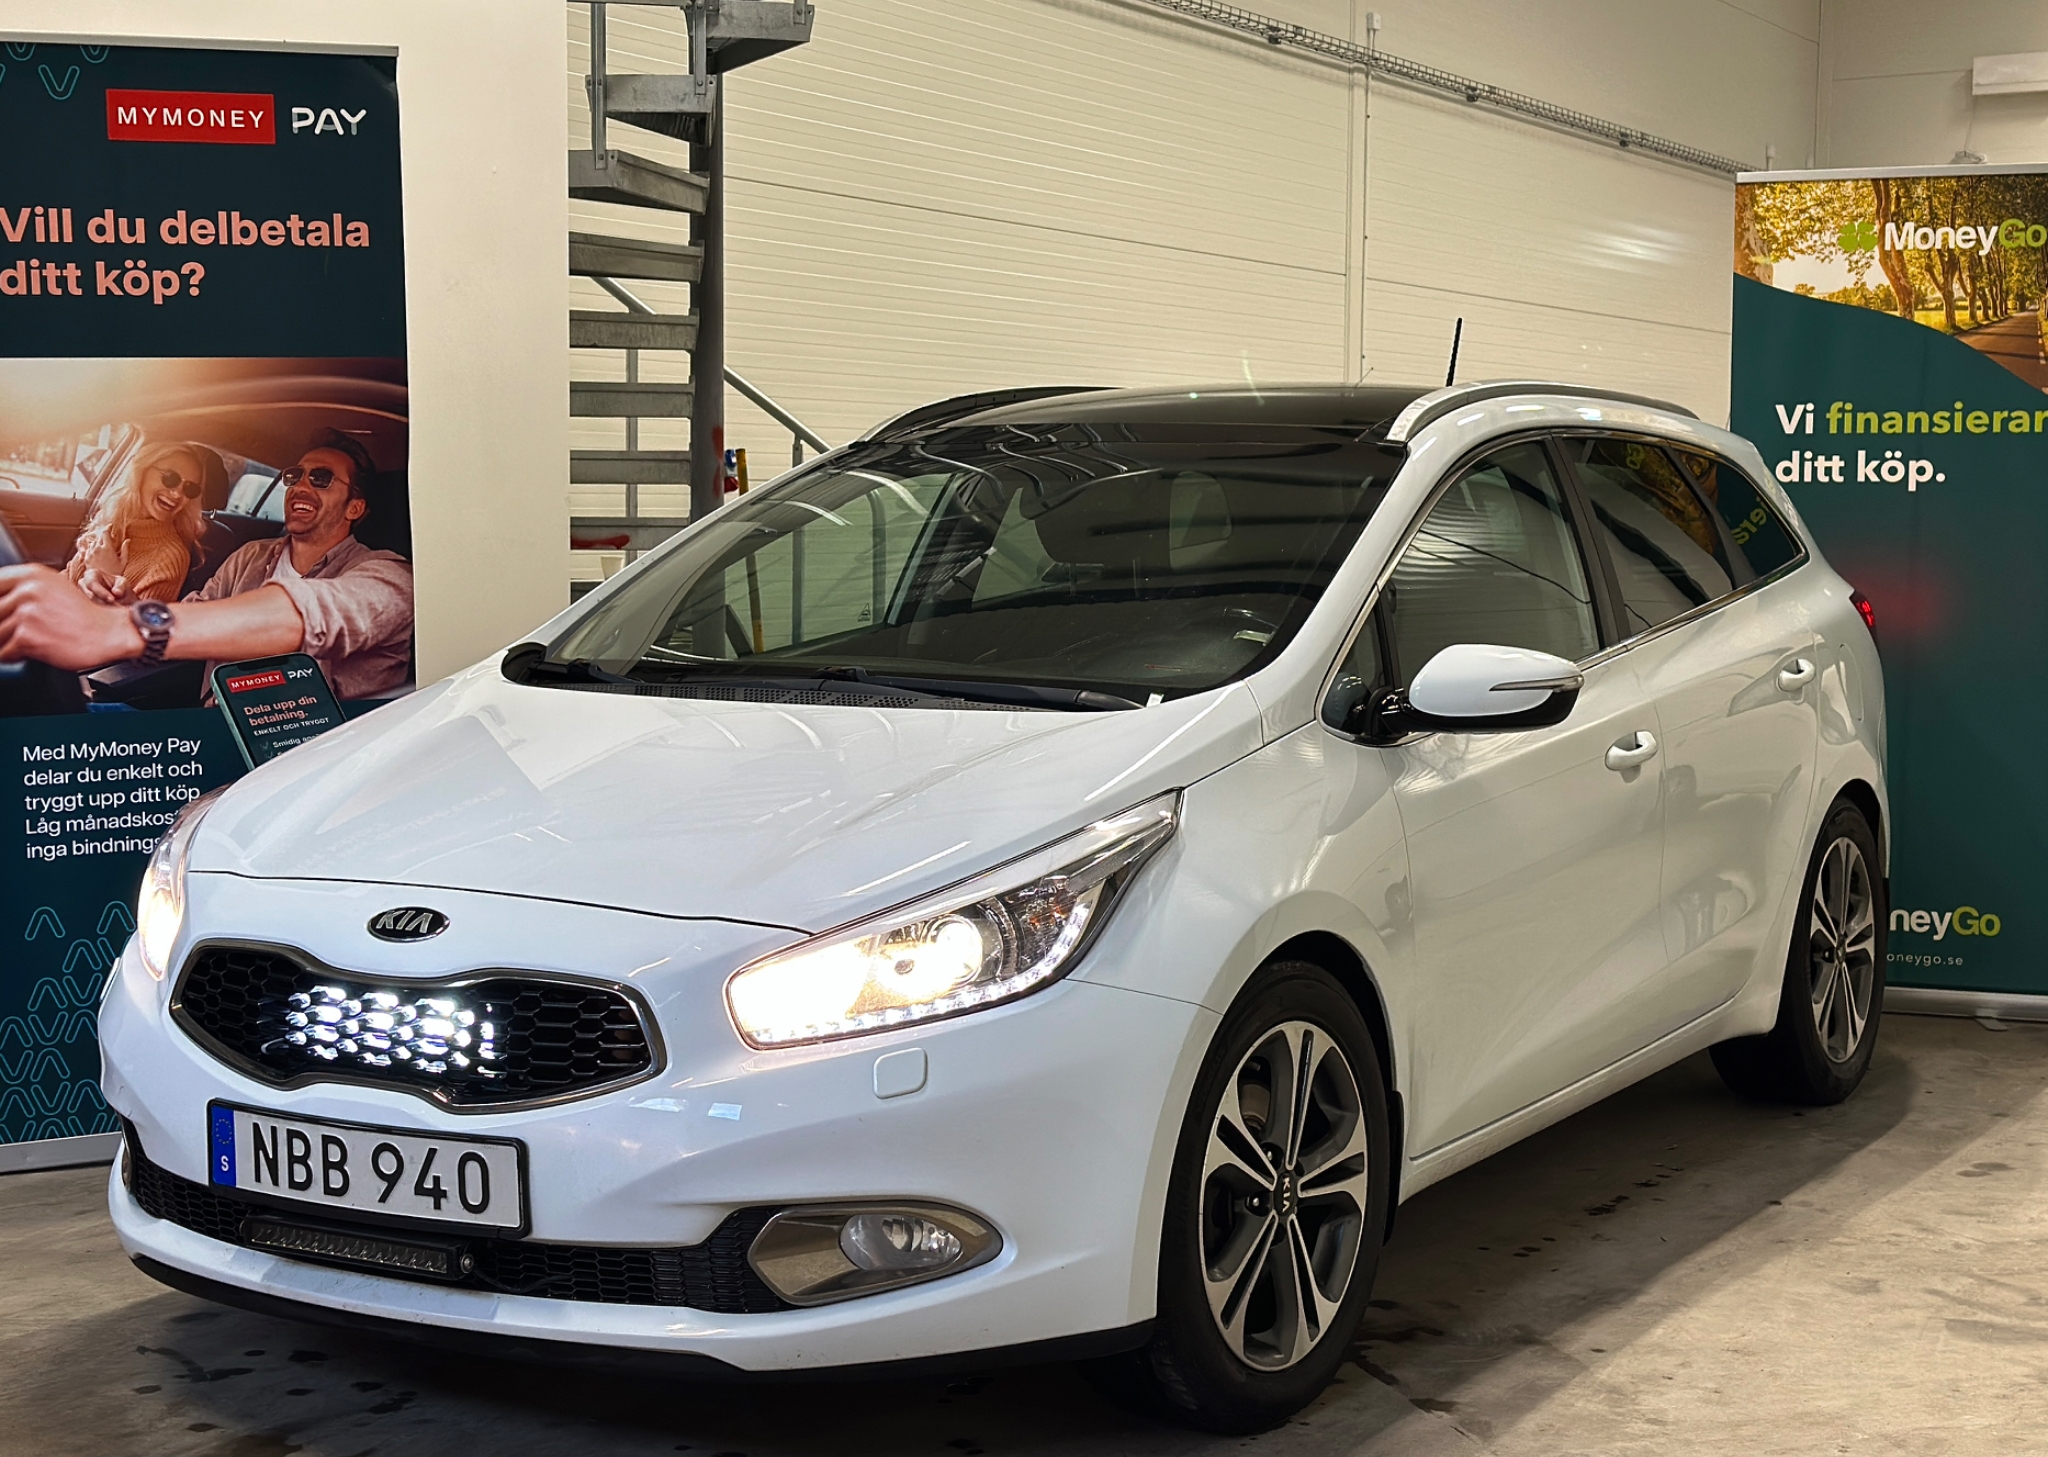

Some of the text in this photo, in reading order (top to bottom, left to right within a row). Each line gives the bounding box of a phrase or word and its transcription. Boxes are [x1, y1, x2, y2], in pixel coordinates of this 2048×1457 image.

[117, 107, 367, 135] MYMONEY PAY
[0, 205, 370, 247] Vill du delbetala
[1884, 218, 2048, 255] MoneyGo
[0, 258, 205, 305] ditt köp?
[1775, 403, 1815, 434] Vi
[1775, 450, 1946, 492] ditt köp.
[231, 668, 313, 689] MYMONEY PAY
[244, 696, 317, 716] Dela upp din
[249, 710, 308, 726] betalning.
[254, 718, 329, 737] ENKELT OCH TRYGGT
[23, 738, 201, 762] Med MyMoney Pay
[24, 760, 203, 786] delar du enkelt och
[25, 793, 84, 813] tryggt
[89, 791, 125, 809] upp
[130, 787, 161, 803] ditt
[25, 817, 61, 837] Låg
[26, 843, 67, 861] inga
[376, 910, 433, 934] KIA
[220, 1154, 229, 1172] S
[252, 1122, 490, 1214] NBB 940
